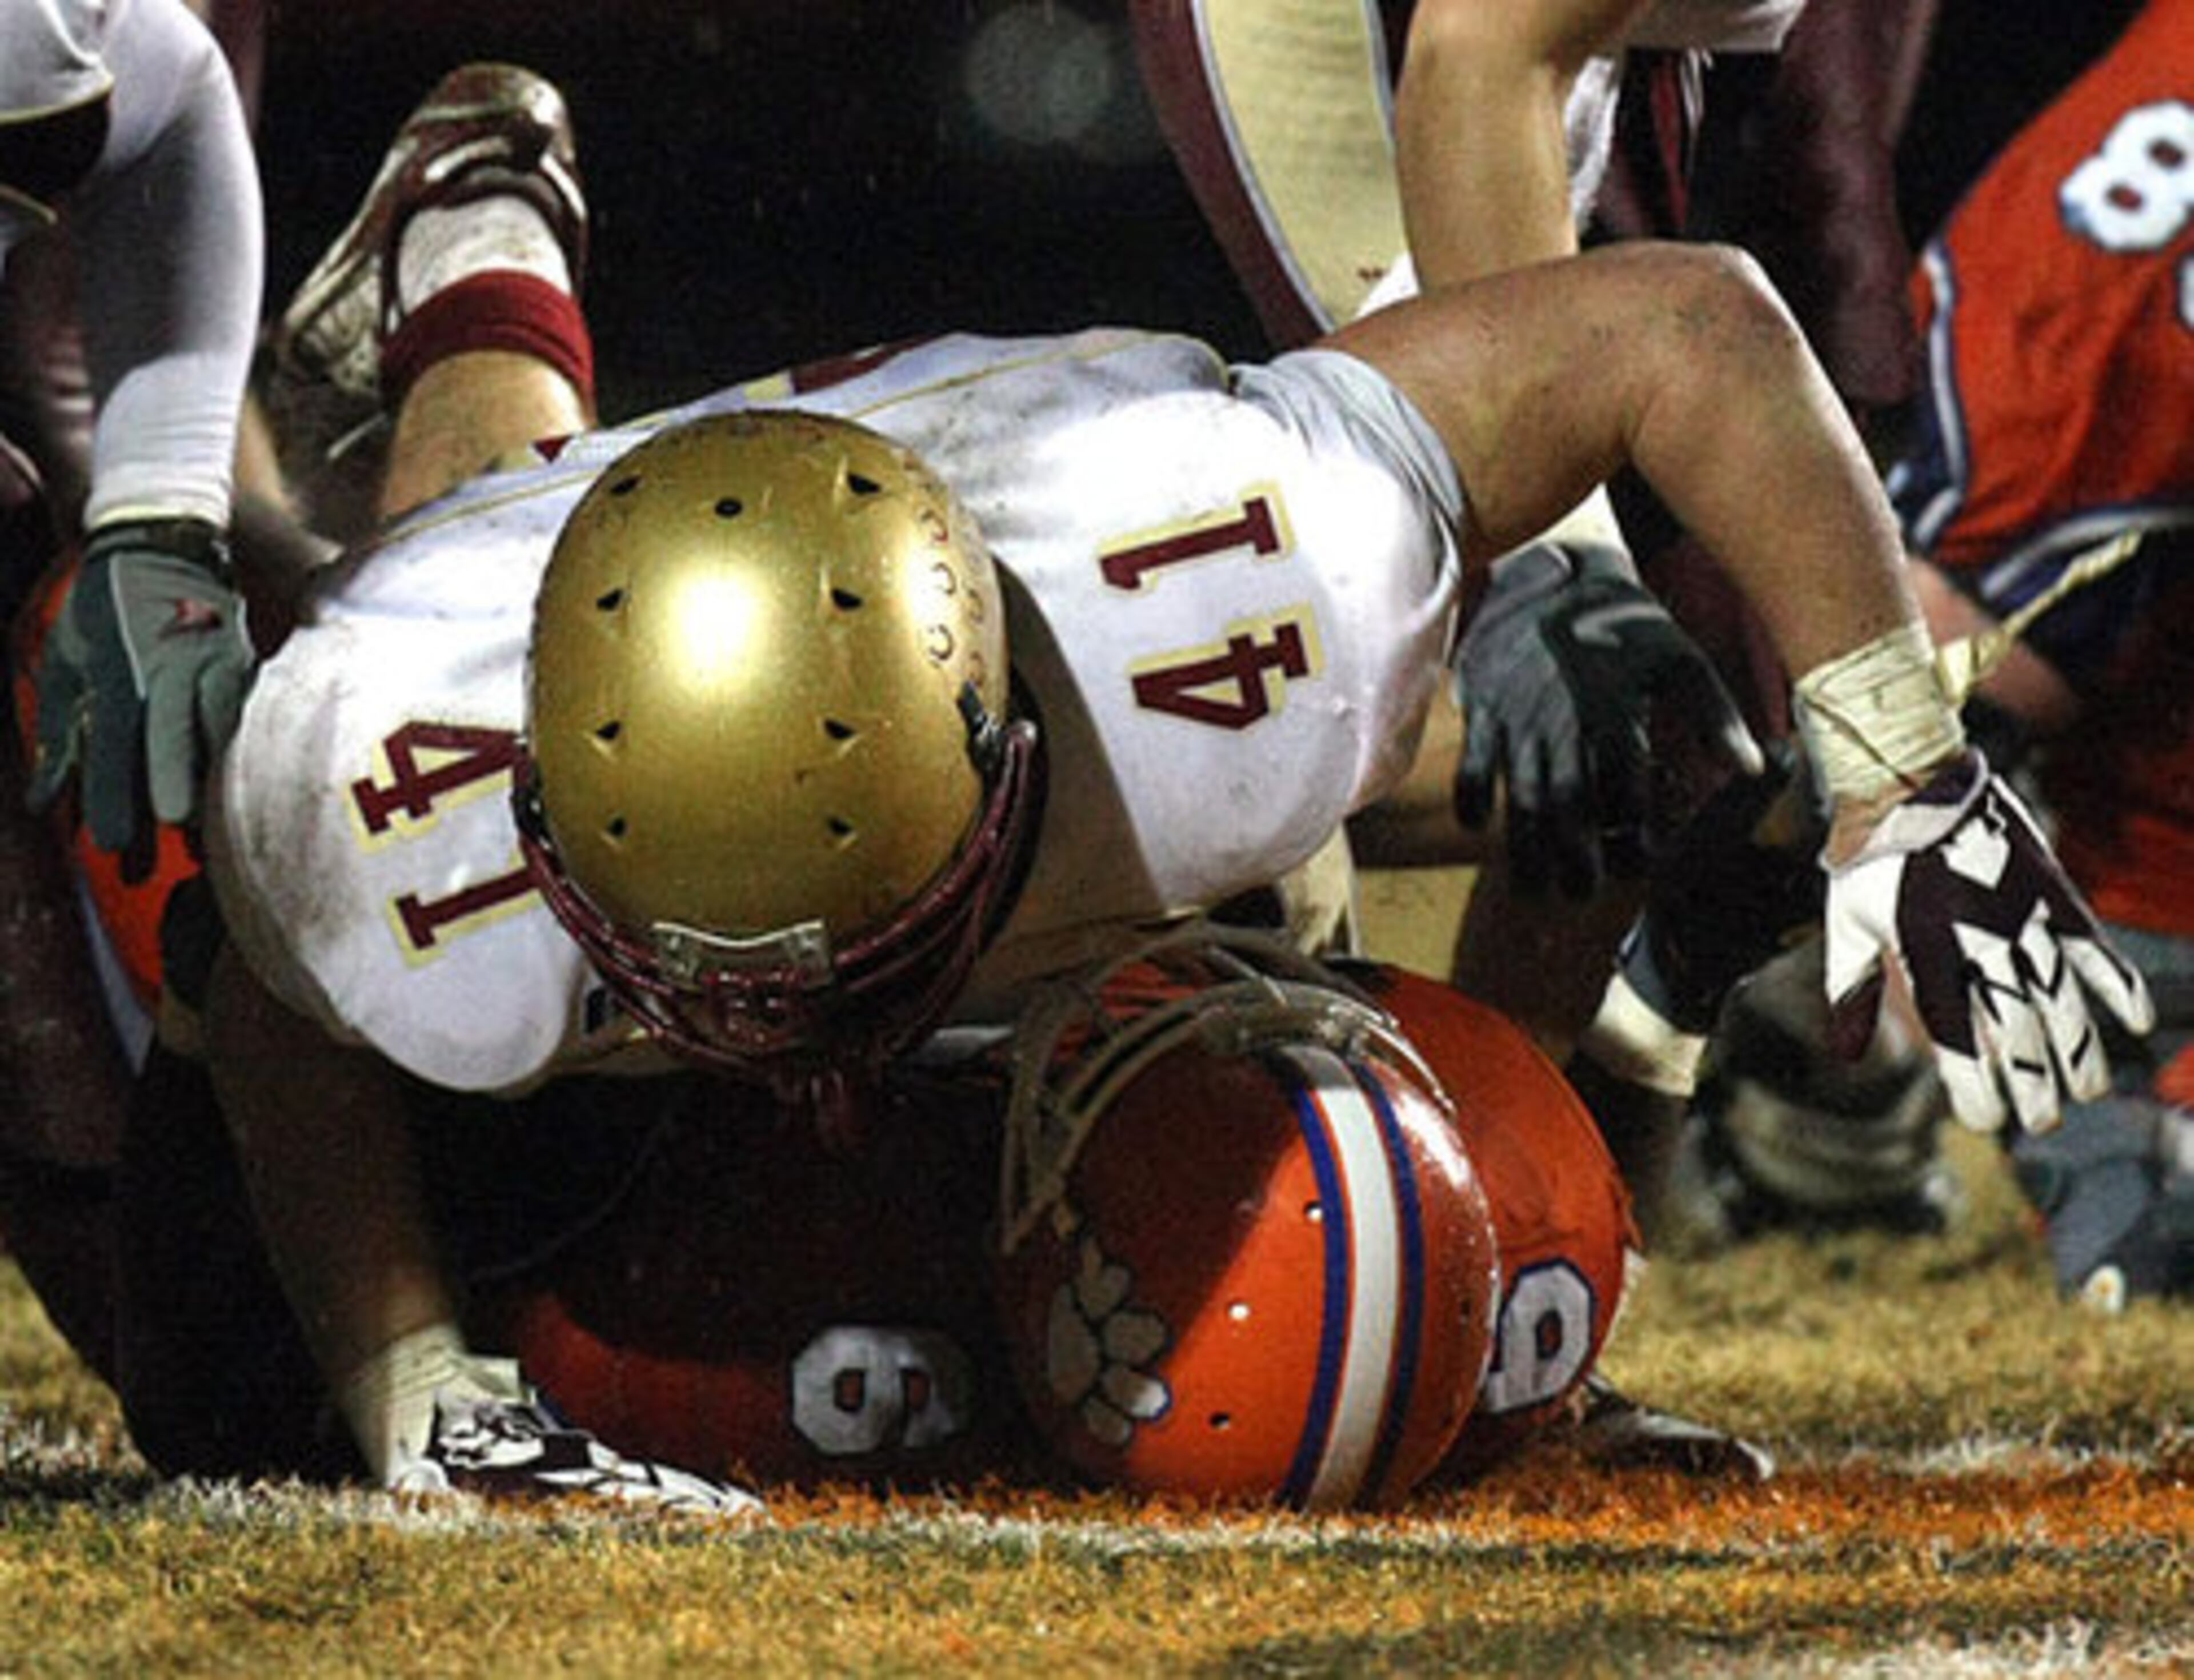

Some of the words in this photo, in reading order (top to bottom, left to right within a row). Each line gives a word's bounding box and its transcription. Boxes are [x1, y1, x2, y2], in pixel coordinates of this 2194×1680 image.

[2059, 98, 2194, 332] 8
[1094, 479, 1326, 732] 41
[347, 719, 540, 967] 41
